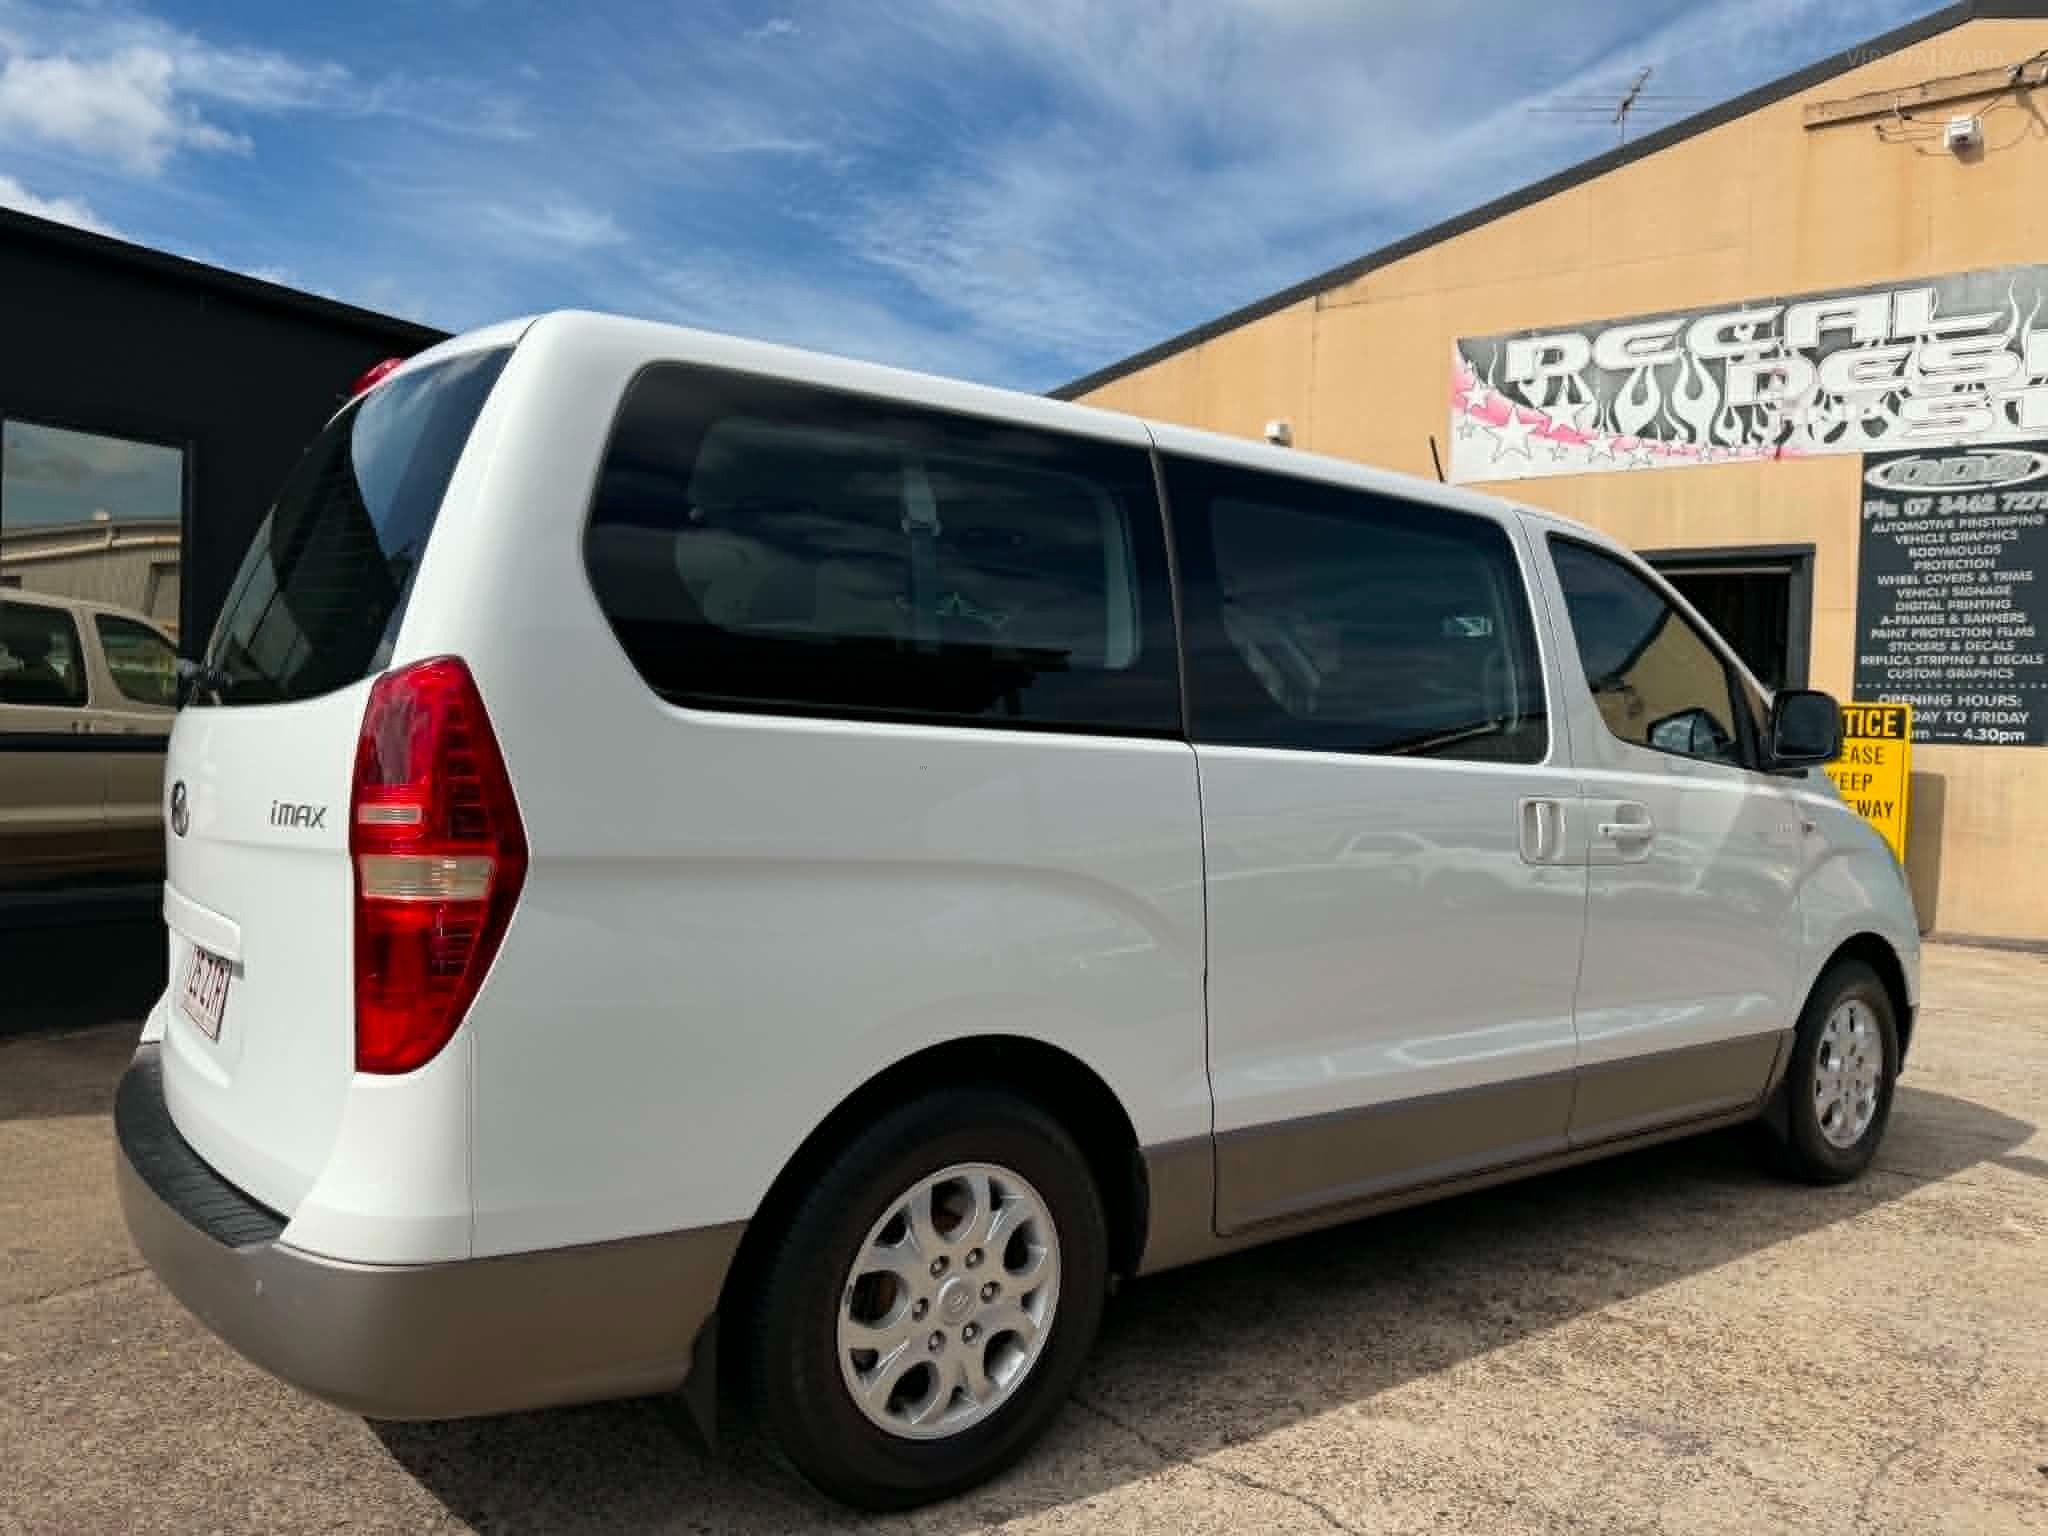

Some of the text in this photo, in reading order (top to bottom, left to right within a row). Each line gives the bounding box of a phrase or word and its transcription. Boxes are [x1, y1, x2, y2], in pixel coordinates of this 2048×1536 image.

[1904, 497, 1933, 515] 07
[1871, 514, 2045, 534] AUTOMOTIVE PINSTRIPING
[1895, 529, 2018, 545] VEHICLE GRAPHICS
[1908, 544, 2002, 558] BODYMOULDS
[1913, 558, 1995, 571] PROTECTION
[1877, 570, 2033, 585] WHEEL COVERS & TRIMS
[1896, 585, 2012, 600] VEHICLE SIGNAGE
[1895, 599, 2012, 612] DIGITAL PRINTING
[1880, 612, 2026, 625] A-FRAMES & BANNERS
[1871, 626, 2035, 640] PAINT PROTECTION FILMS
[1887, 640, 2015, 652] STICKERS & DECALS
[1860, 654, 2044, 665] REPLICA STRIPING & DECALS
[1887, 667, 2015, 679] CUSTOM GRAPHICS
[1878, 693, 2022, 707] OPENING HOURS:
[1842, 709, 1896, 737] TICE
[1911, 711, 2030, 724] DAY TO FRIDAY
[1963, 728, 2025, 744] 4.30pm
[1840, 745, 1886, 765] EASE
